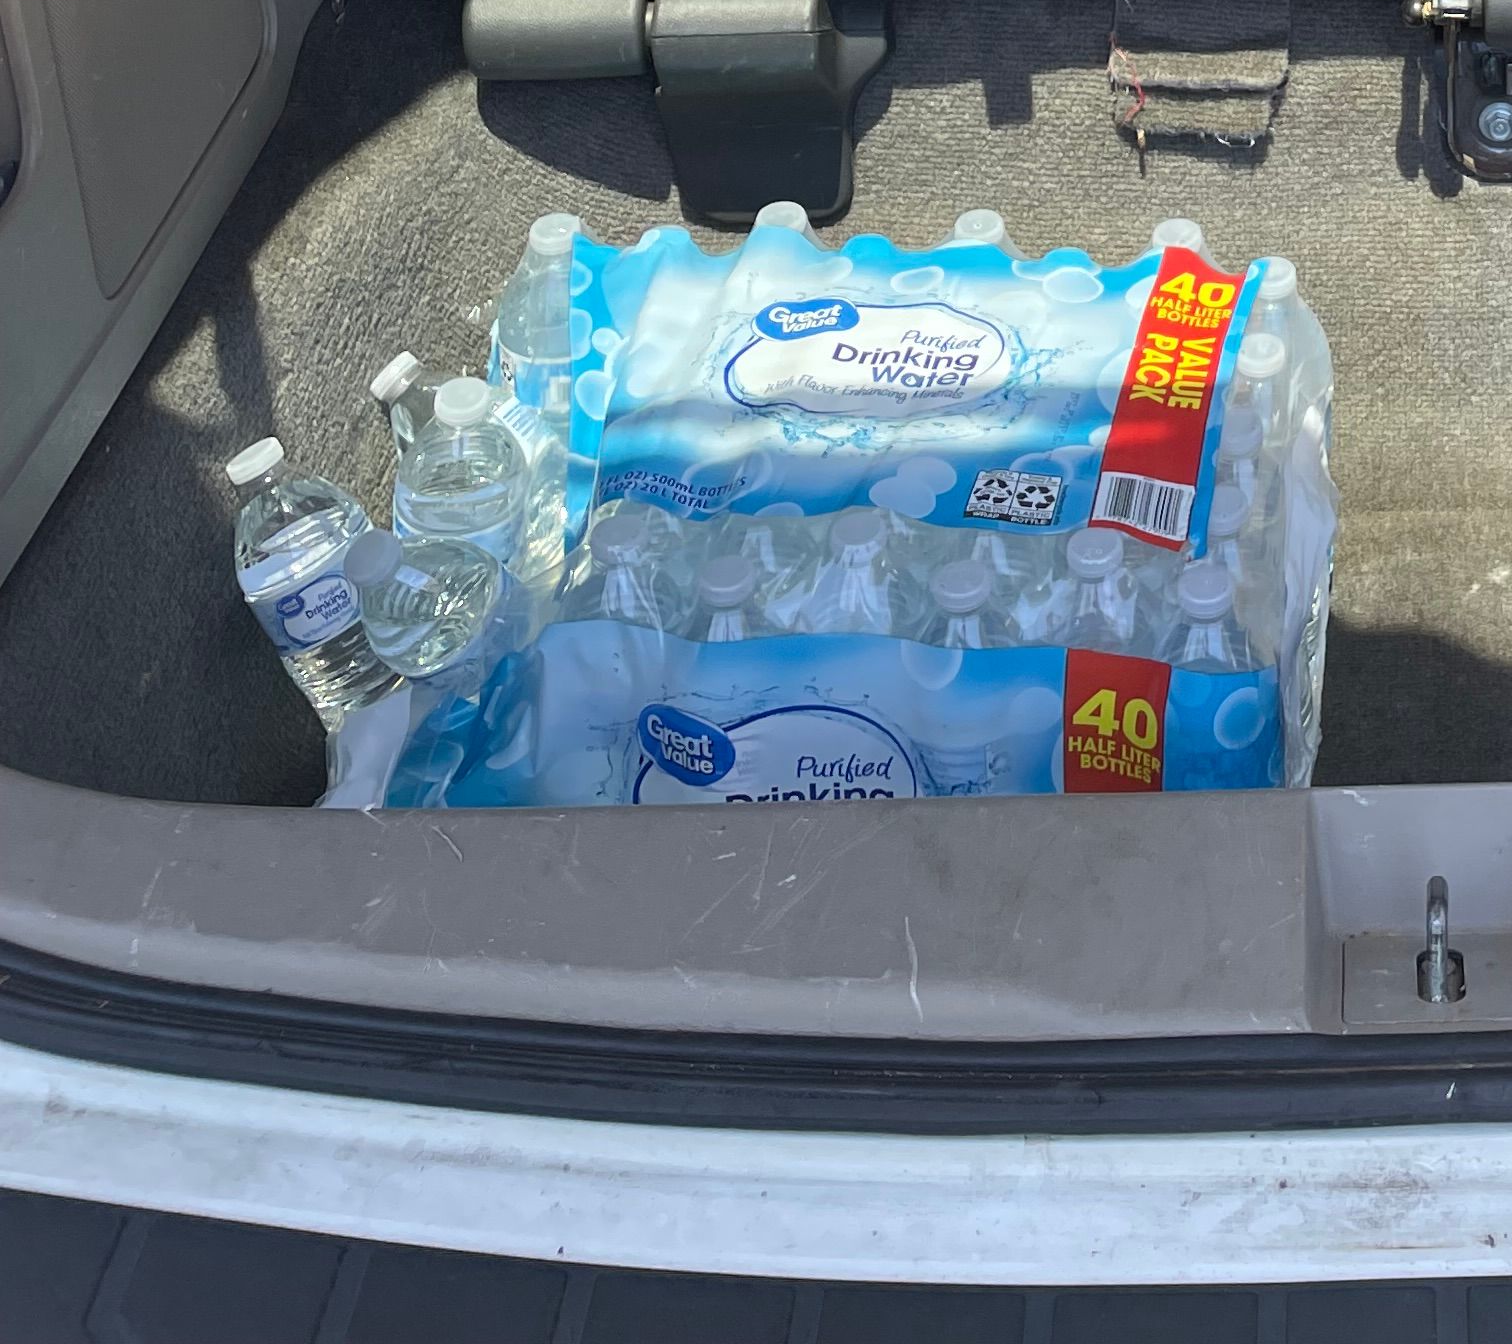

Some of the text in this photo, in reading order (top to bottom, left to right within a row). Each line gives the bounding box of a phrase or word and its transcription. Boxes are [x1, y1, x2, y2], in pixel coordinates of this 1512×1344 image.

[1159, 272, 1236, 307] 40
[768, 304, 843, 325] Great
[1151, 296, 1232, 320] HALF LITER
[1157, 308, 1220, 328] BOTTLES
[782, 316, 838, 333] Value
[900, 330, 988, 353] Purified
[831, 342, 980, 372] Drinking
[1129, 333, 1179, 404] PACK
[871, 366, 974, 388] Water
[1167, 337, 1216, 410] VALUE
[798, 374, 837, 394] Flavor
[841, 385, 907, 404] Enhancing
[911, 387, 964, 400] Minerals
[624, 470, 648, 481] OZ)
[652, 471, 695, 496] 500mL
[640, 482, 659, 494] 20
[672, 490, 709, 510] TOTAL
[972, 511, 1000, 519] WRAP
[1010, 516, 1050, 525] BOTTLE
[305, 589, 349, 620] Drinking
[321, 597, 351, 621] Water
[1072, 688, 1159, 750] 40
[647, 713, 714, 759] Great
[660, 742, 715, 775] Value
[797, 753, 895, 783] Purified
[1068, 736, 1161, 773] HALF LITER
[1080, 753, 1152, 784] BOTTLES
